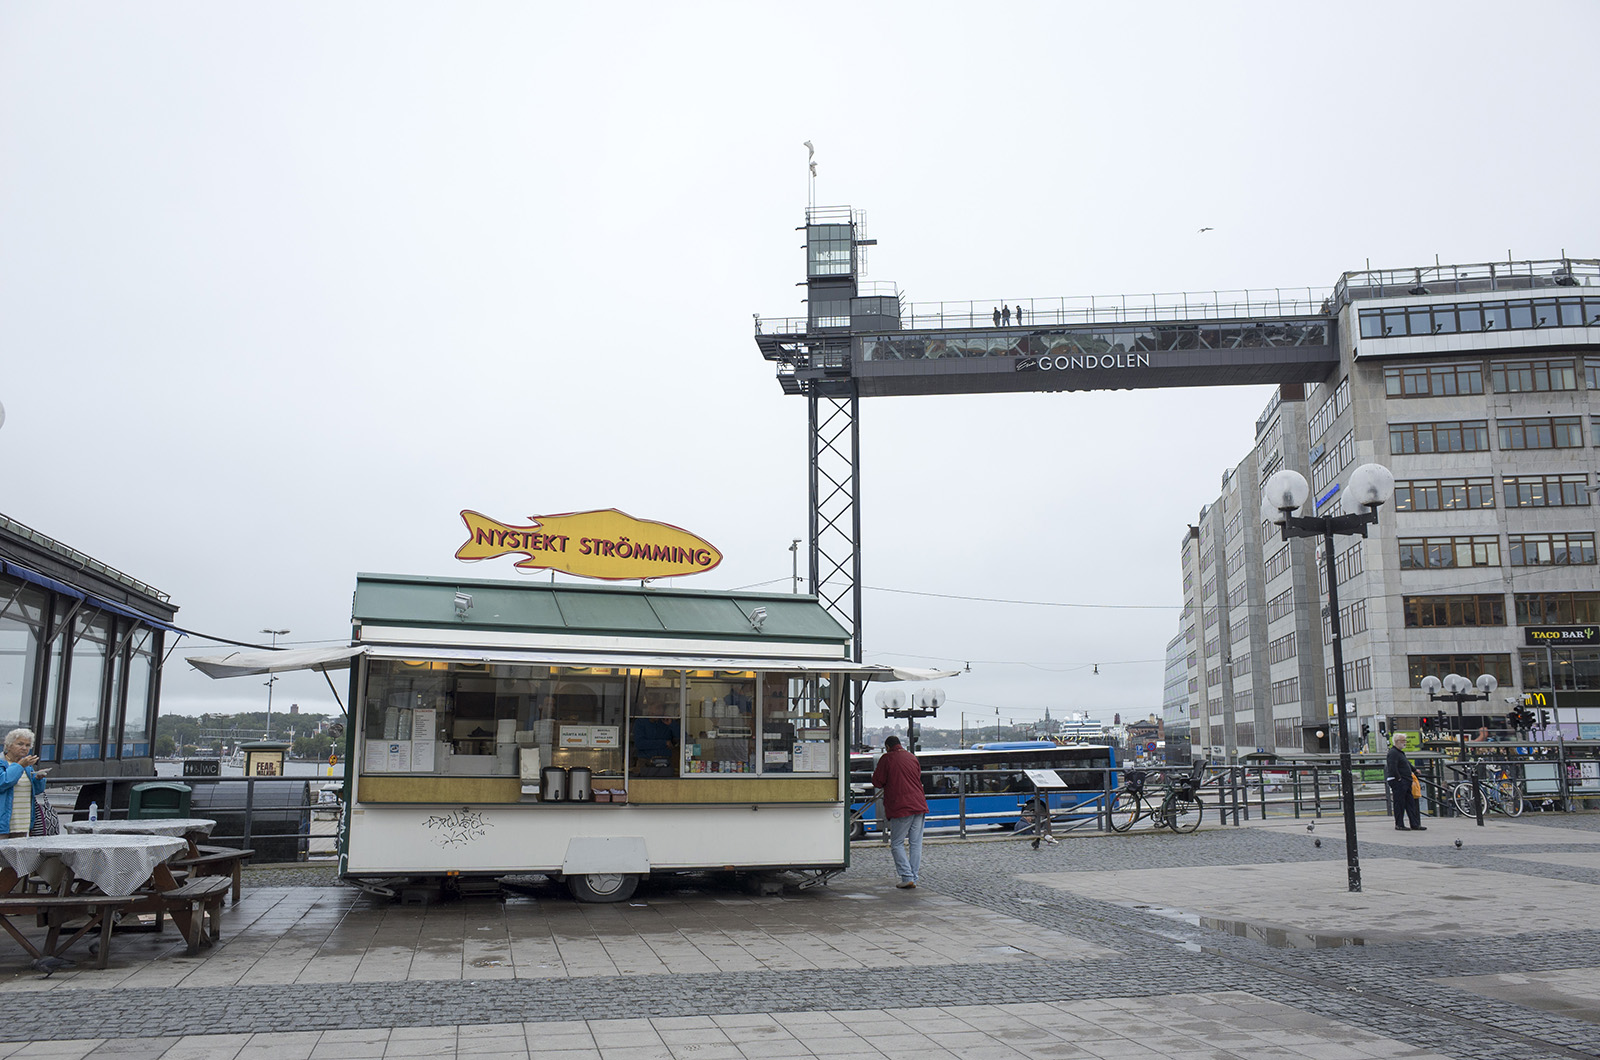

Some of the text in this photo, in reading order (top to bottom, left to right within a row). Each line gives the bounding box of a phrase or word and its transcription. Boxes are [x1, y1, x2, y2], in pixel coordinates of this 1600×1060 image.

[1038, 353, 1150, 371] GONDOLEN
[475, 526, 712, 567] NYSTEKT STRÖMMING
[1531, 630, 1585, 639] TACO BAR
[203, 765, 216, 773] WC
[256, 762, 274, 771] FEAR
